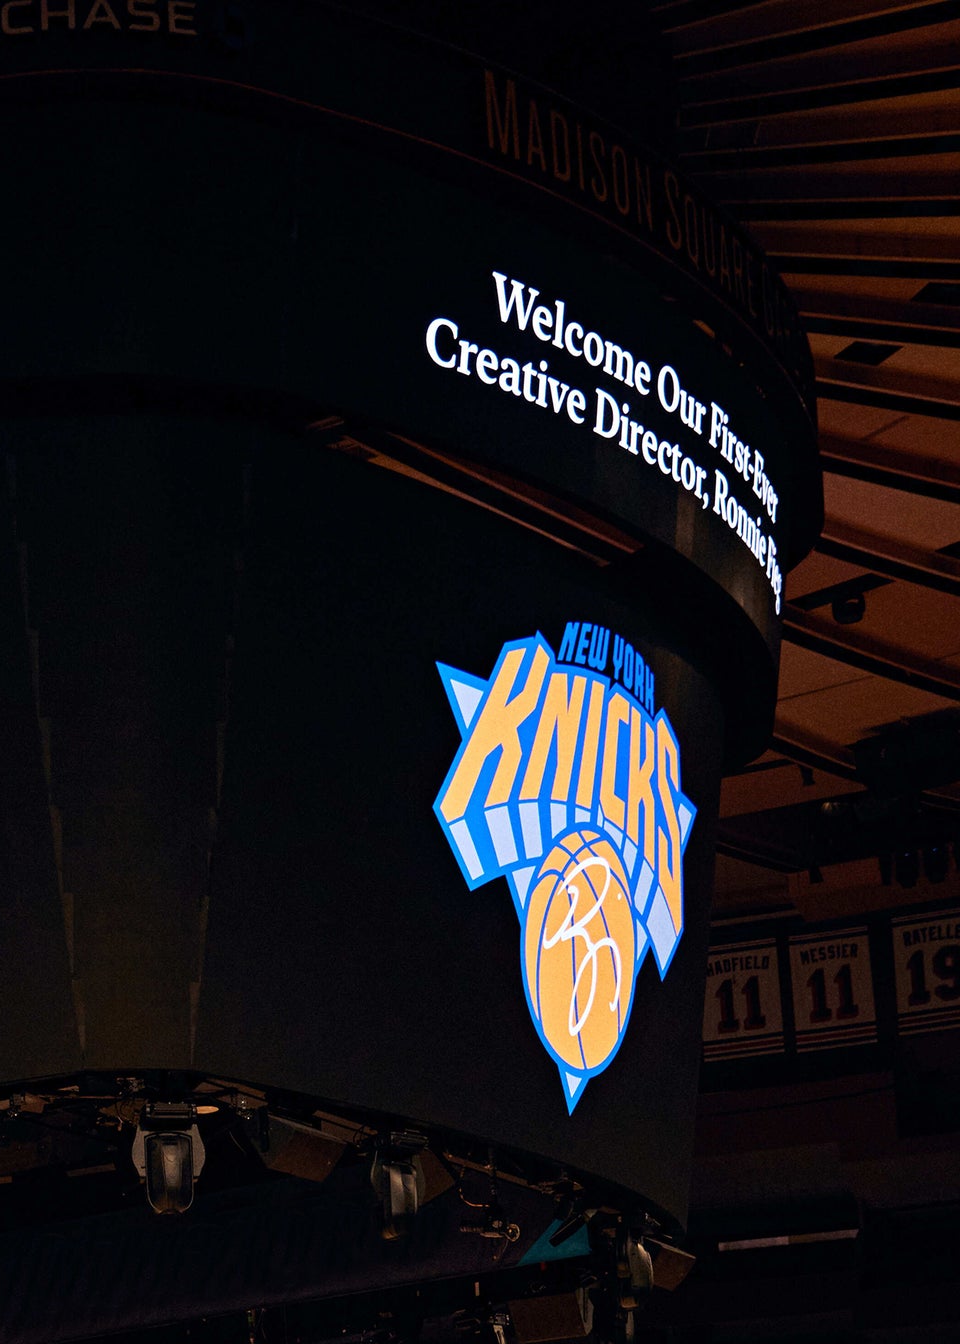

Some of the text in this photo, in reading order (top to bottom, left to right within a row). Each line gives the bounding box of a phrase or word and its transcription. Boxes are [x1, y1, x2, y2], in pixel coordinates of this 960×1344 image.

[0, 0, 199, 37] CHASE
[484, 68, 654, 232] MADISON
[492, 271, 652, 395] Welcome
[656, 364, 706, 436] Our
[708, 401, 779, 524] First-Ever
[425, 317, 586, 425] Creative
[592, 386, 710, 510] Director,
[712, 468, 767, 568] Ronnie
[557, 621, 656, 717] NEW YORK
[439, 643, 683, 938] KNICKS
[800, 944, 859, 965] MESSIER
[807, 964, 859, 1024] 11
[906, 945, 960, 1007] 19
[715, 975, 766, 1034] 11
